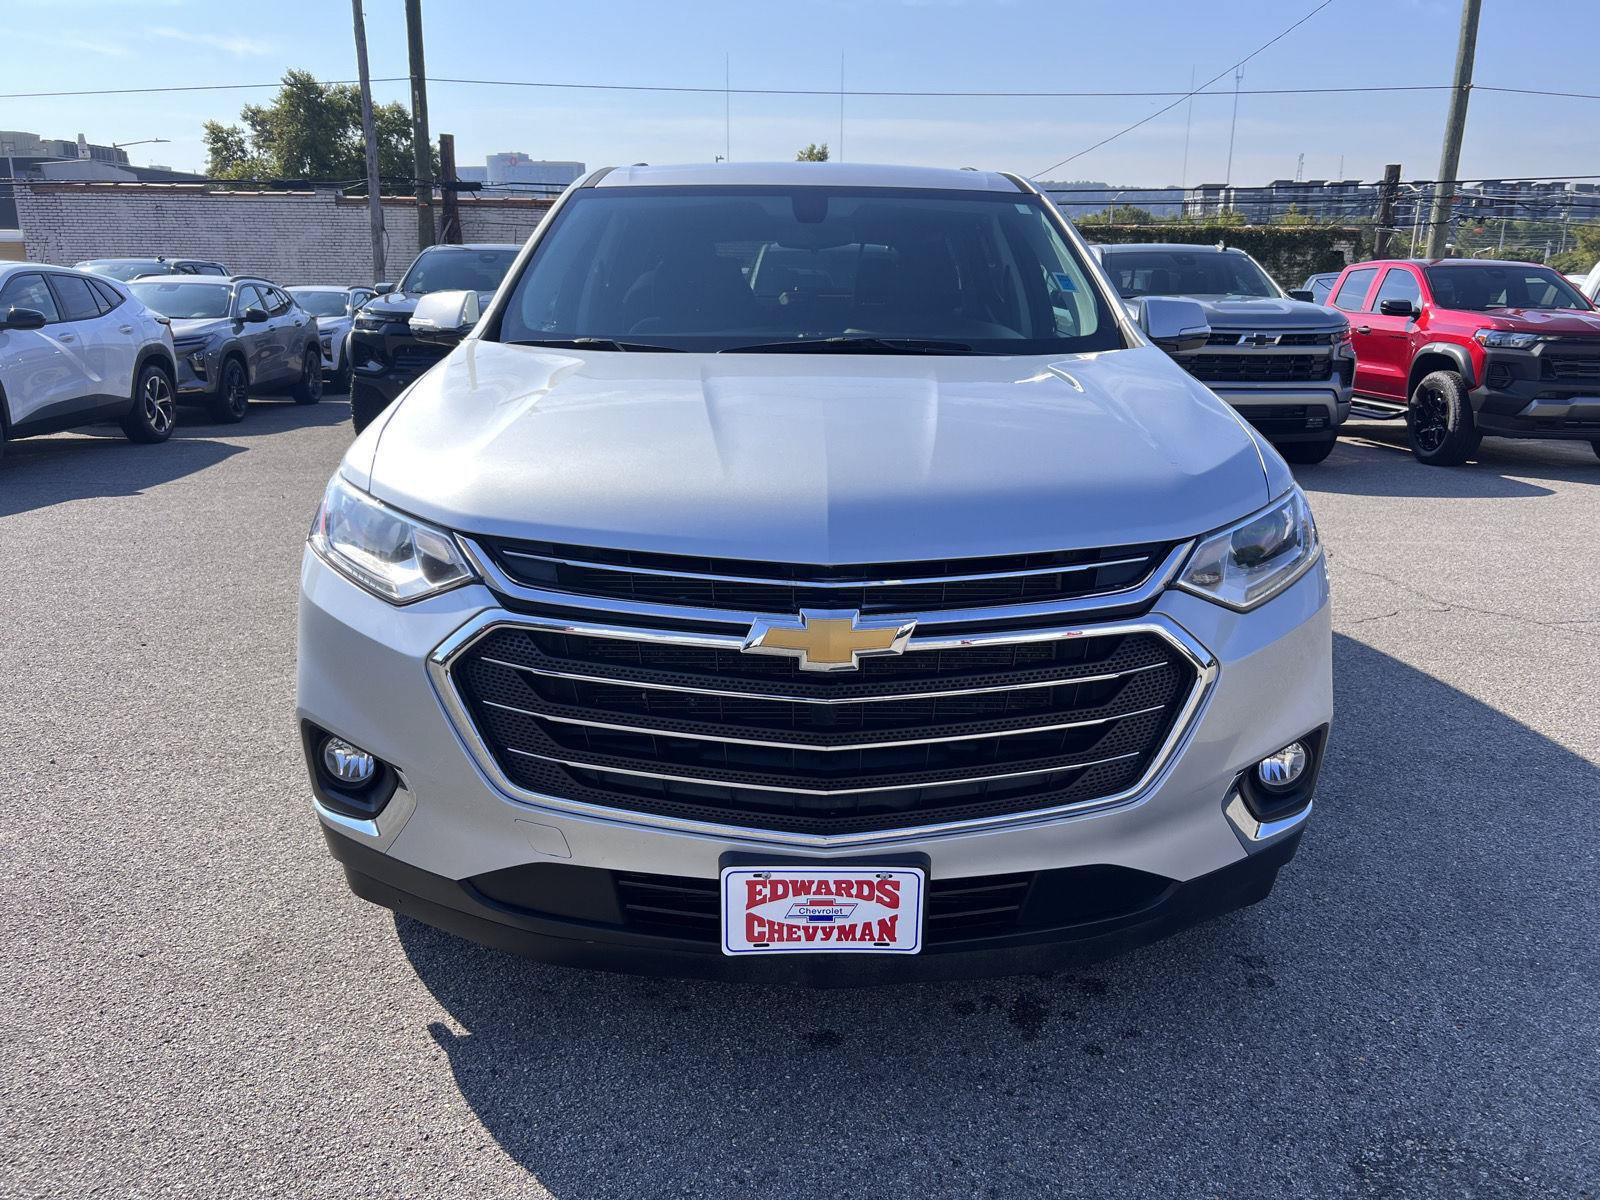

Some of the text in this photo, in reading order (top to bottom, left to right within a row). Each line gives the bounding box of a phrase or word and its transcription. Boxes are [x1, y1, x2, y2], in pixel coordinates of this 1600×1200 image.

[746, 879, 900, 910] EDWARDS
[798, 907, 843, 915] Chevrolet
[746, 912, 899, 942] CHEVYMAN
